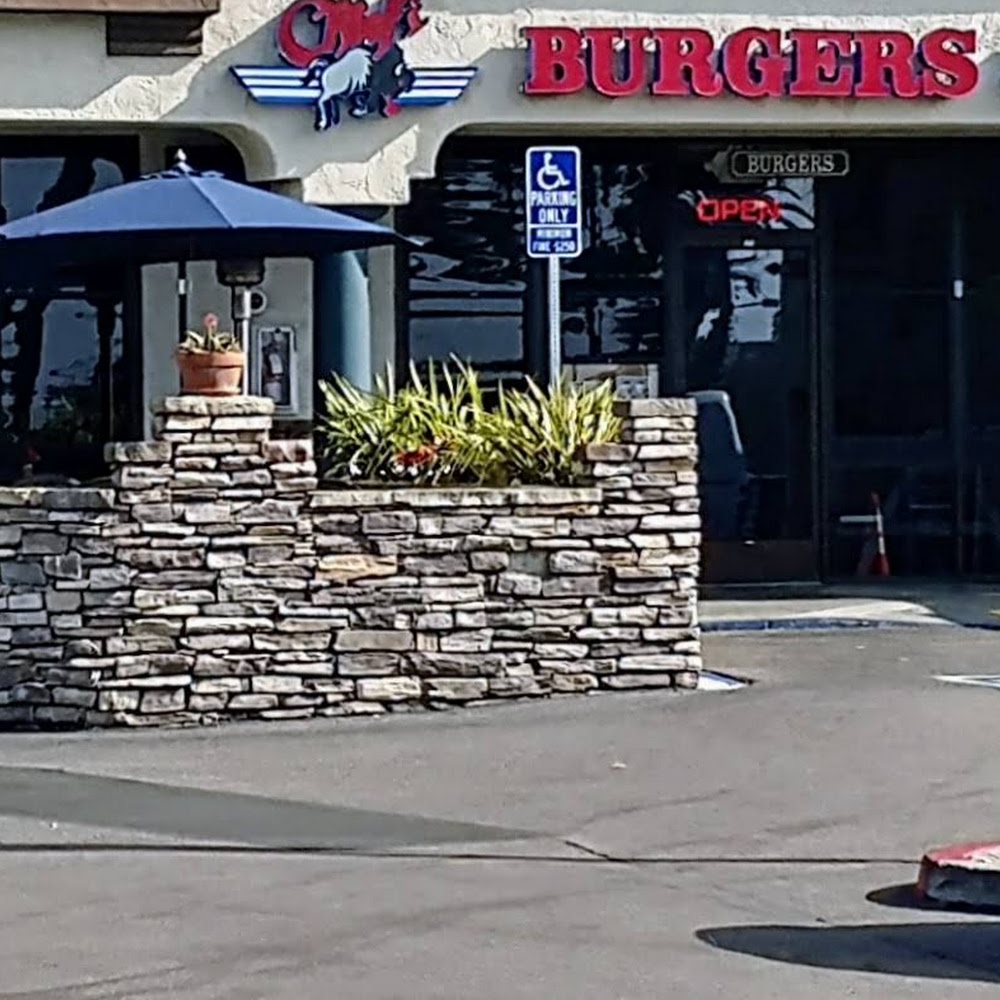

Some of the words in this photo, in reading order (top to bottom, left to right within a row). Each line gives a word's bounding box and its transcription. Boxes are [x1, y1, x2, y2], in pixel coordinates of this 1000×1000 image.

[521, 26, 980, 98] BURGERS
[747, 154, 835, 173] BURGERS
[530, 190, 577, 206] PARKING
[538, 208, 569, 223] ONLY
[696, 199, 783, 222] OPEN
